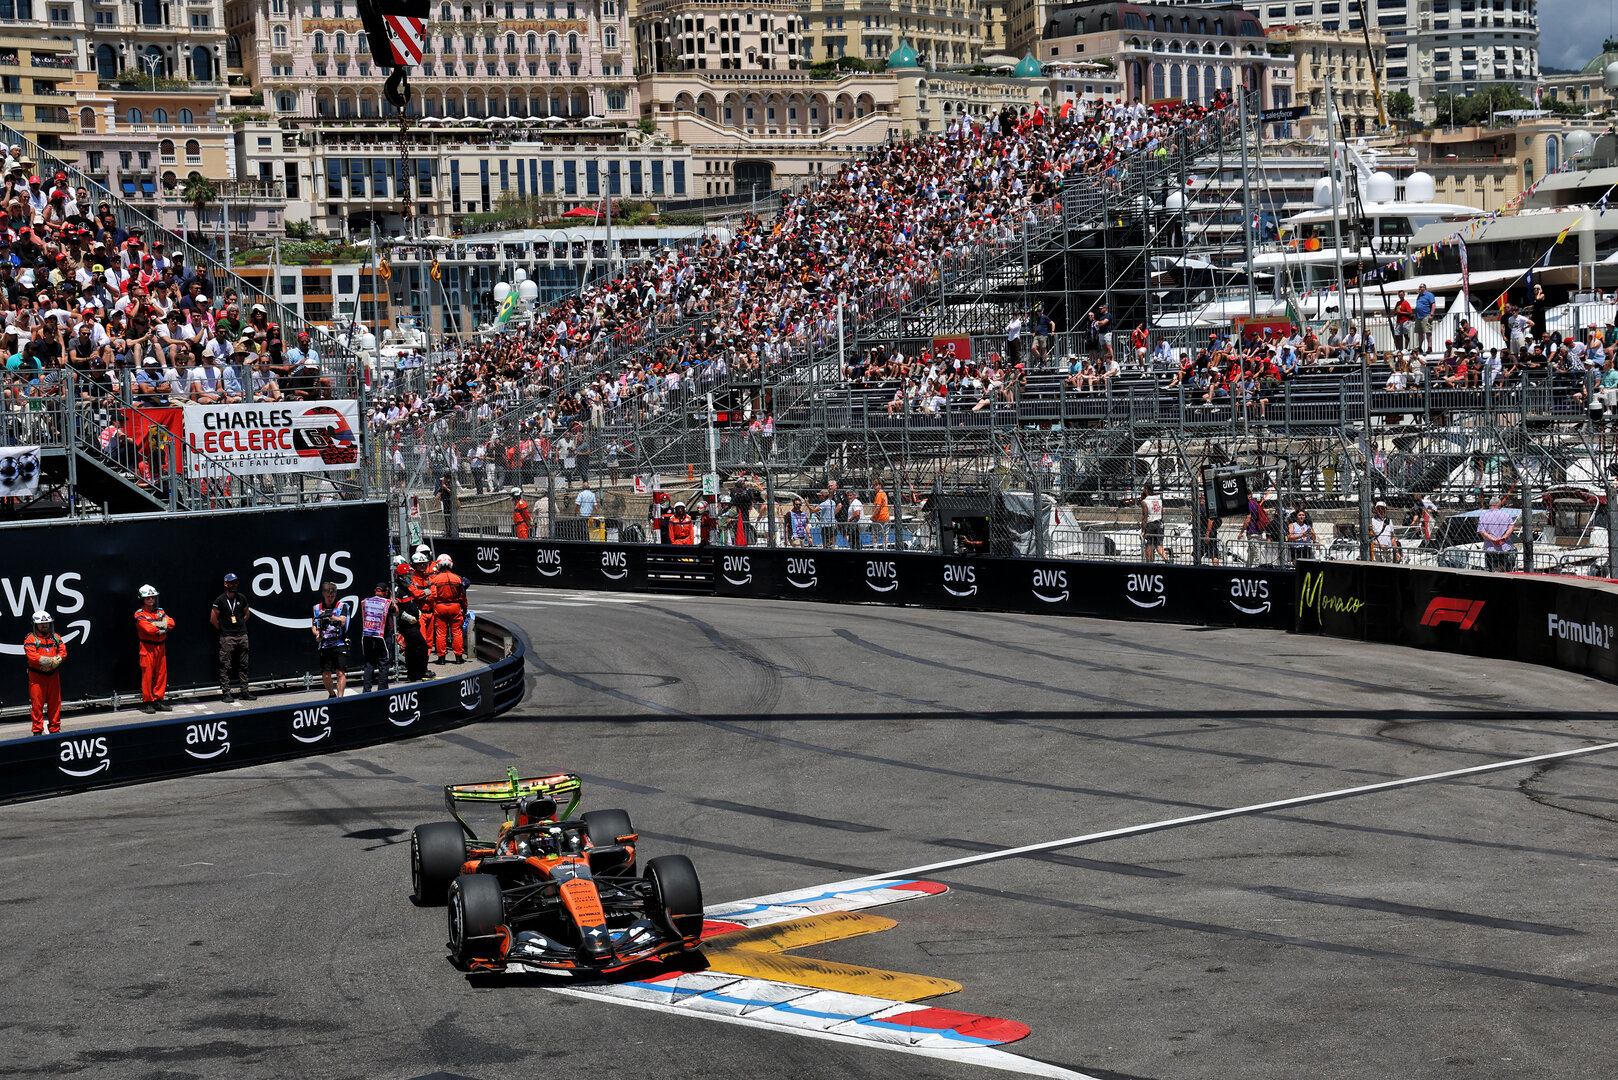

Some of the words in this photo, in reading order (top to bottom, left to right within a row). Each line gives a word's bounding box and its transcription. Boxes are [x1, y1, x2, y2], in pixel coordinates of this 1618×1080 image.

[203, 409, 293, 430] CHARLES
[189, 428, 292, 454] LECLERC
[239, 452, 286, 460] OFFICIAL
[250, 459, 268, 467] FAN
[275, 458, 299, 466] CLUB
[478, 547, 499, 561] aws
[537, 549, 561, 564] aws
[602, 552, 627, 567] aws
[252, 550, 354, 597] aws
[724, 556, 750, 572] aws
[788, 558, 816, 574] aws
[867, 561, 897, 578] aws
[944, 565, 976, 582] aws
[1033, 569, 1068, 587] aws
[1127, 574, 1164, 592] aws
[0, 572, 85, 617] ws
[1231, 578, 1269, 598] aws
[1299, 570, 1365, 625] Monaco
[460, 676, 480, 697] aws
[389, 691, 419, 713] aws
[293, 706, 330, 729] aws
[185, 720, 228, 744] aws
[60, 737, 108, 761] aws
